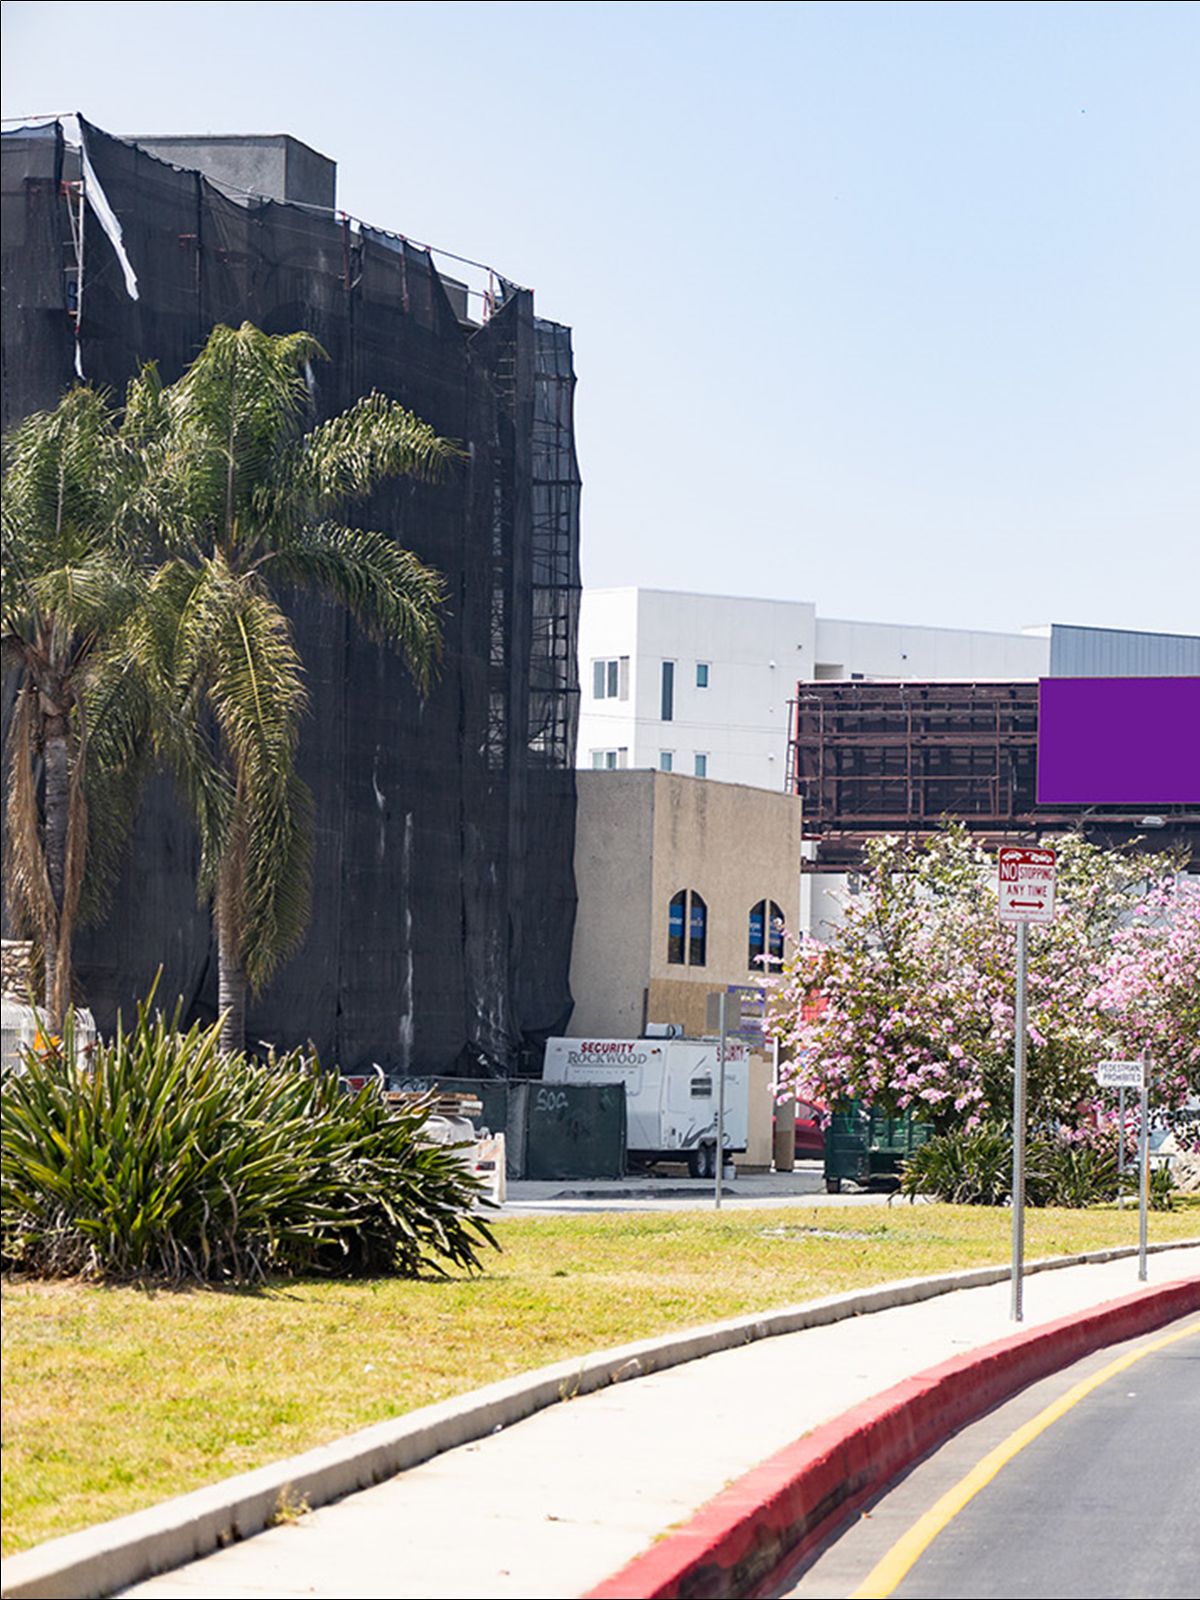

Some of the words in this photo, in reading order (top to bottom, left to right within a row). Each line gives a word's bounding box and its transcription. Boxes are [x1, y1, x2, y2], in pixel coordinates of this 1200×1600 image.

[1001, 863, 1017, 880] NO
[1020, 866, 1053, 881] STOPPING
[1006, 884, 1025, 897] ANY
[1028, 885, 1047, 898] TIME
[581, 1042, 635, 1053] SECURITY
[716, 1045, 744, 1062] SCURITY
[1103, 1073, 1142, 1082] PROHIBITED
